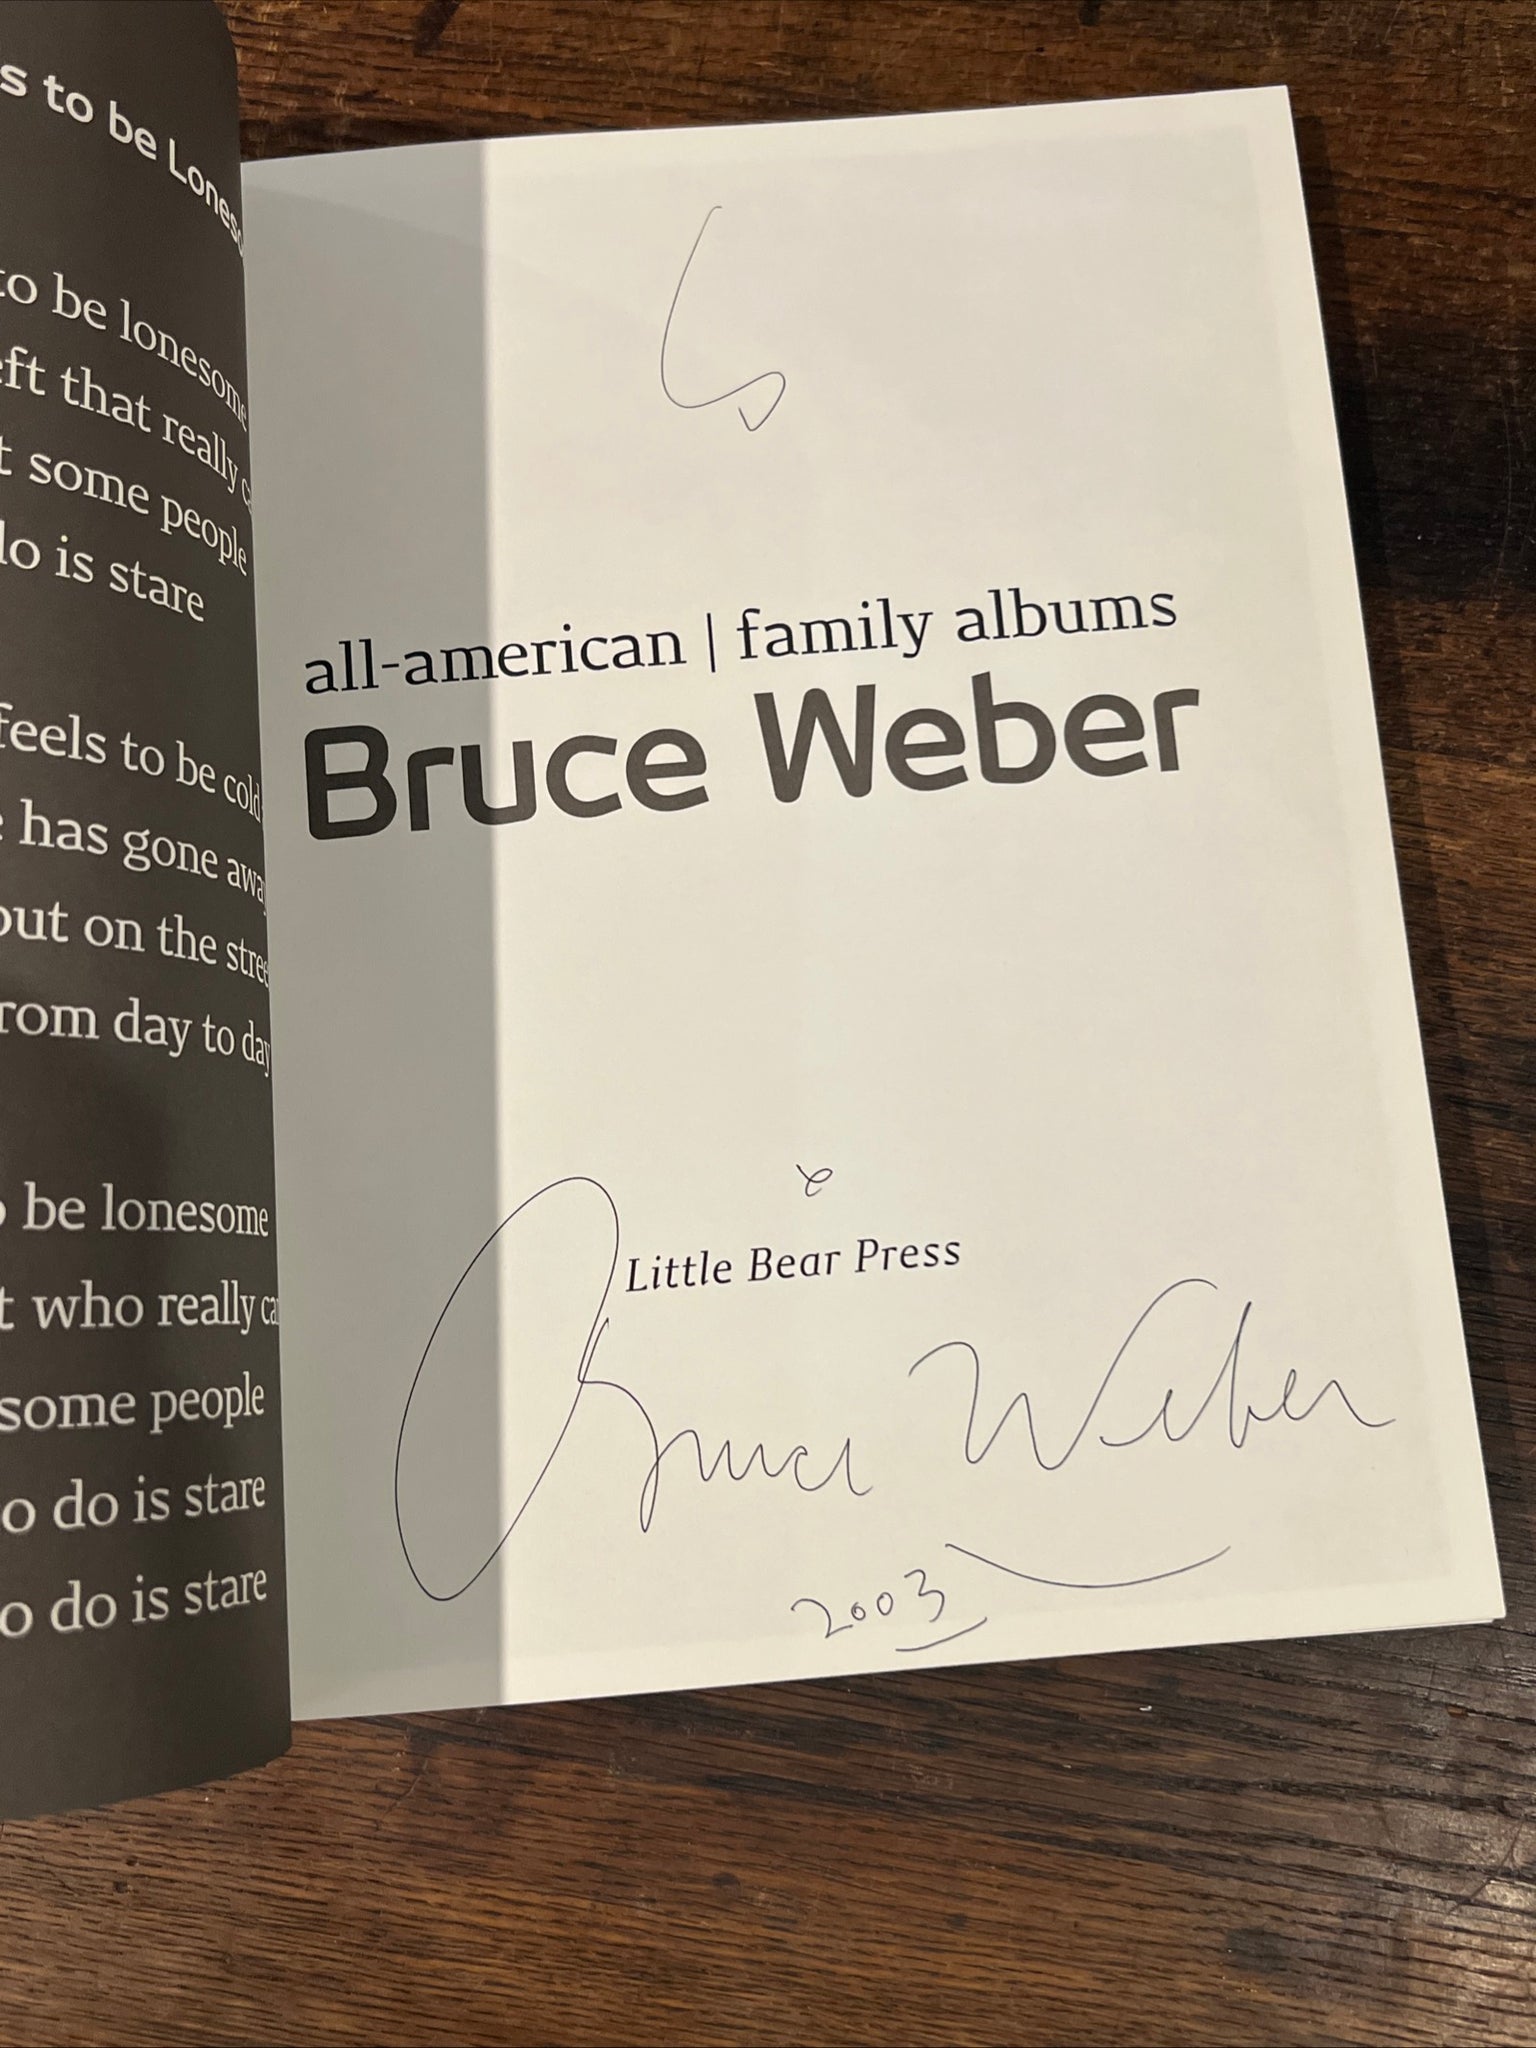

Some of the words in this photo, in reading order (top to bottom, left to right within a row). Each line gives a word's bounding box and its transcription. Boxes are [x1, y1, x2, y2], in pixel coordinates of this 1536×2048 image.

[43, 74, 94, 123] to
[109, 100, 157, 161] be
[0, 269, 38, 305] o
[51, 271, 107, 330] be
[119, 298, 247, 433] lonesome
[0, 345, 46, 396] ft
[59, 366, 152, 433] that
[162, 413, 239, 494] really
[28, 452, 150, 515] some
[160, 495, 247, 577] people
[54, 534, 94, 583] is
[109, 560, 204, 622] stare
[304, 622, 688, 695] all-american
[735, 597, 935, 661] family
[955, 587, 1178, 644] albums
[120, 731, 165, 776] to
[175, 739, 216, 794] be
[223, 774, 261, 823] cold
[304, 724, 709, 841] Bruce
[754, 671, 1200, 803] Weber
[18, 797, 109, 855] has
[122, 828, 219, 879] gone
[226, 858, 267, 917] awa
[83, 915, 146, 953] on
[156, 913, 217, 965] the
[113, 996, 193, 1058] day
[201, 1014, 235, 1056] to
[241, 1019, 271, 1078] day
[22, 1180, 86, 1231] be
[101, 1182, 269, 1237] lonesome
[31, 1279, 144, 1330] who
[157, 1279, 256, 1336] really
[624, 1249, 733, 1293] Little
[746, 1246, 842, 1283] Bear
[853, 1238, 961, 1274] Press
[0, 1393, 136, 1433] some
[150, 1370, 265, 1434] people
[53, 1478, 119, 1530] do
[133, 1475, 170, 1522] is
[185, 1474, 266, 1517] stare
[50, 1579, 117, 1633] do
[132, 1574, 169, 1623] is
[184, 1569, 267, 1615] stare
[789, 1568, 946, 1640] 2003
